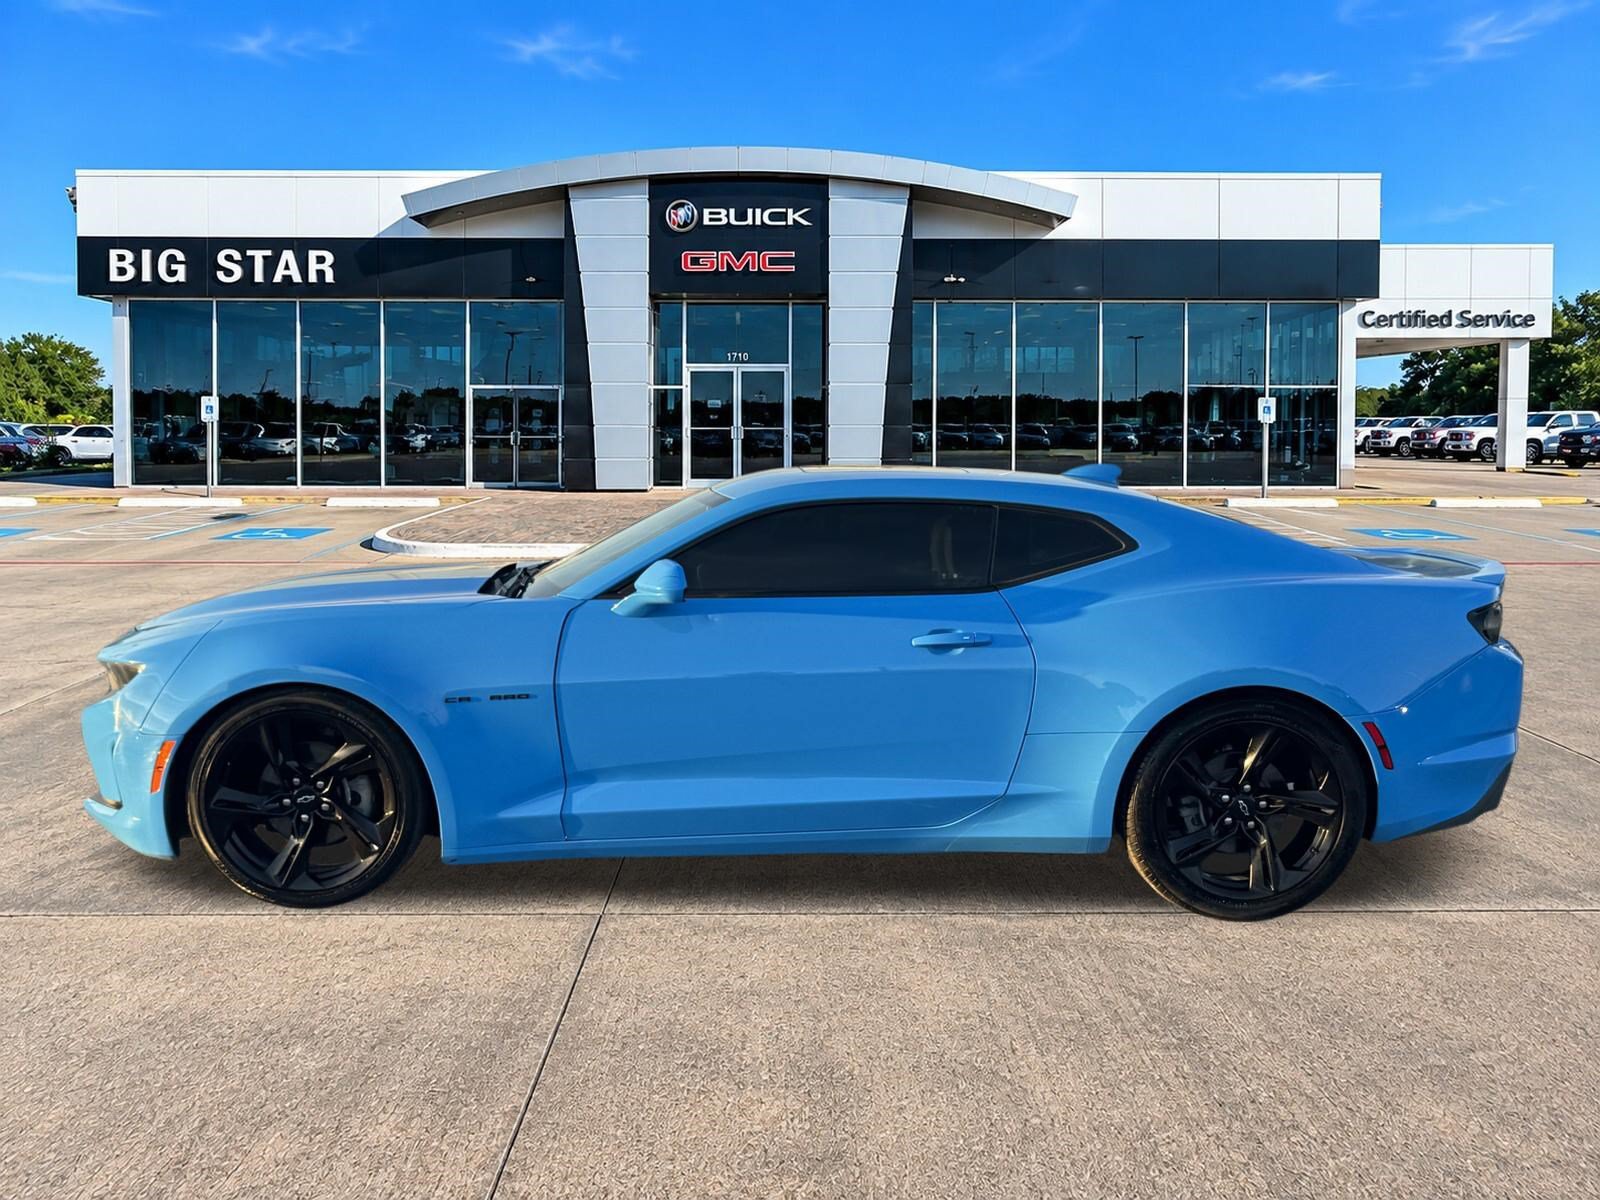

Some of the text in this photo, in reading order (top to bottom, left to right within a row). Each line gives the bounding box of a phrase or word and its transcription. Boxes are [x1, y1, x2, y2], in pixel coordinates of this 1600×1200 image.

[702, 208, 813, 226] BUICK
[108, 249, 336, 283] BIG STAR
[681, 251, 796, 272] GMC
[1358, 310, 1536, 329] Certified Service
[727, 352, 749, 361] 1710
